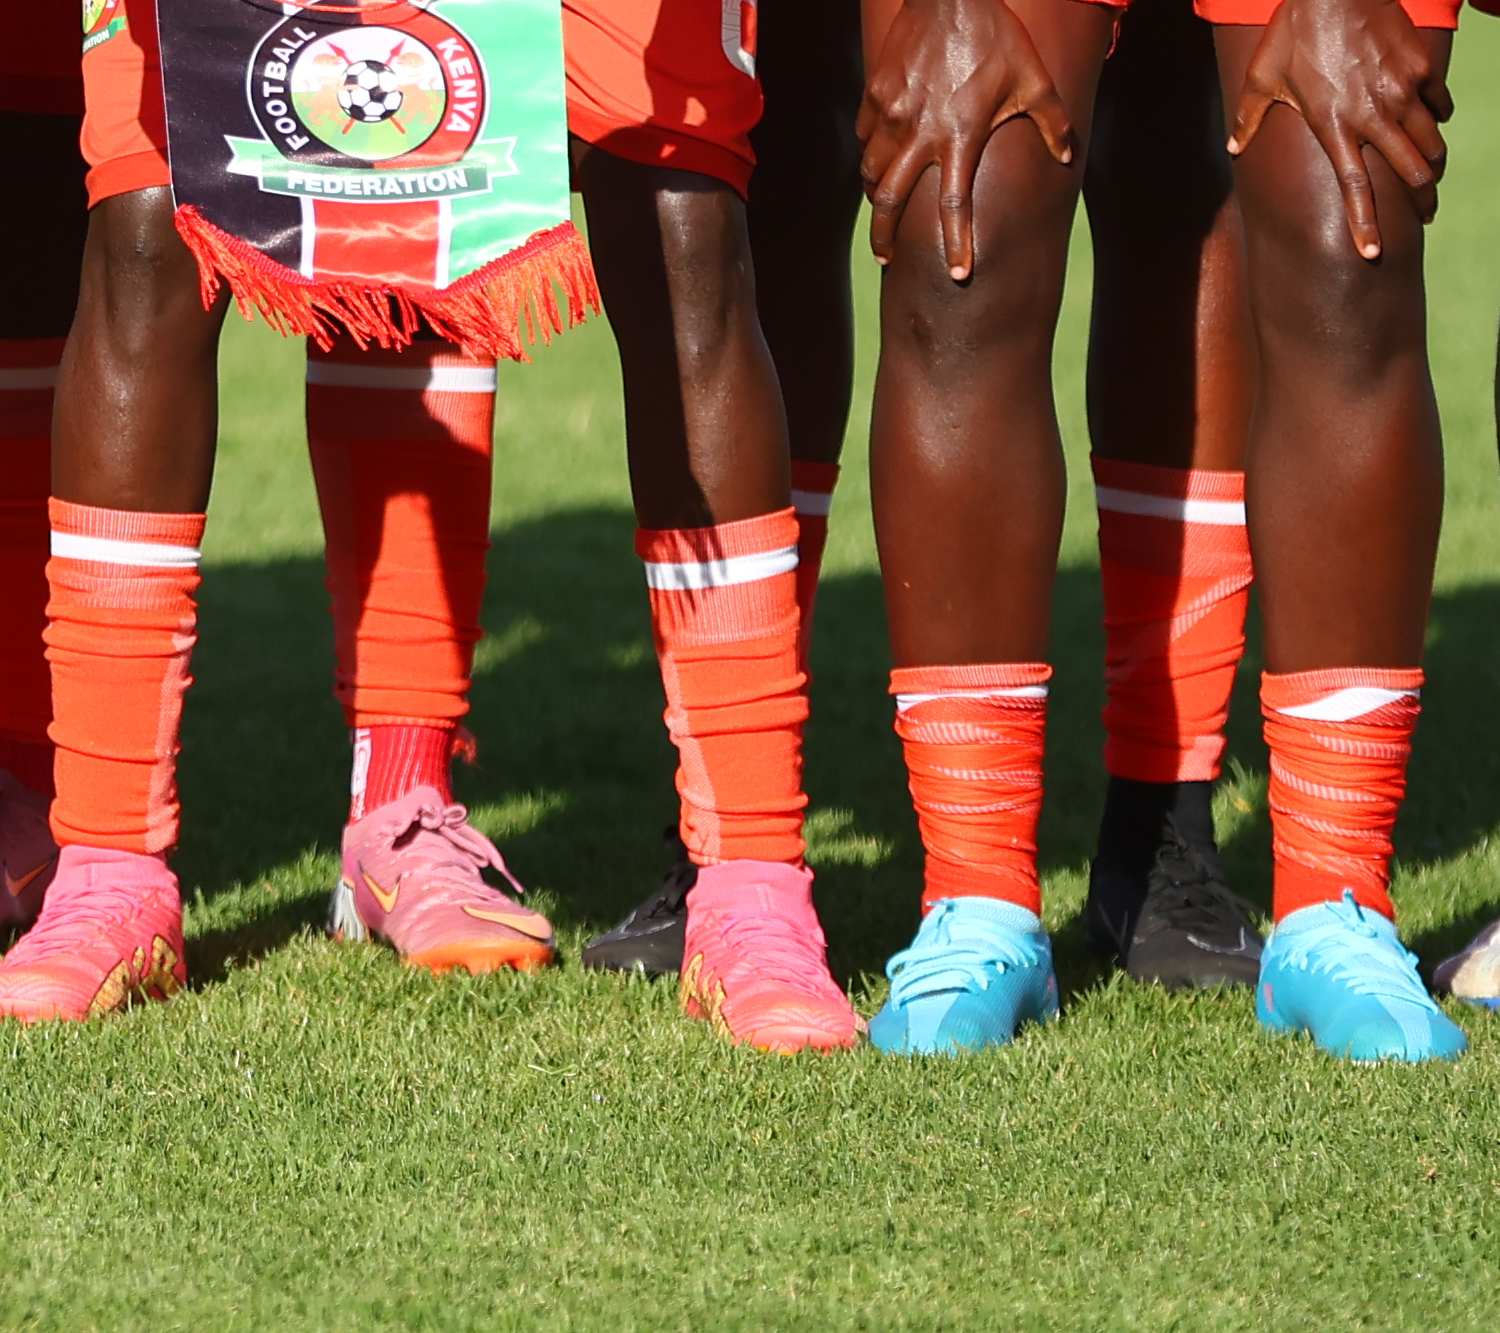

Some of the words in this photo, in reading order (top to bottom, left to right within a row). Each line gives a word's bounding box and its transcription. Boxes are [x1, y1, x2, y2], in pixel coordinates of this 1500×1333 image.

[264, 25, 317, 152] FOOTBALL
[435, 37, 479, 134] KENYA
[286, 169, 470, 196] FEDERATION
